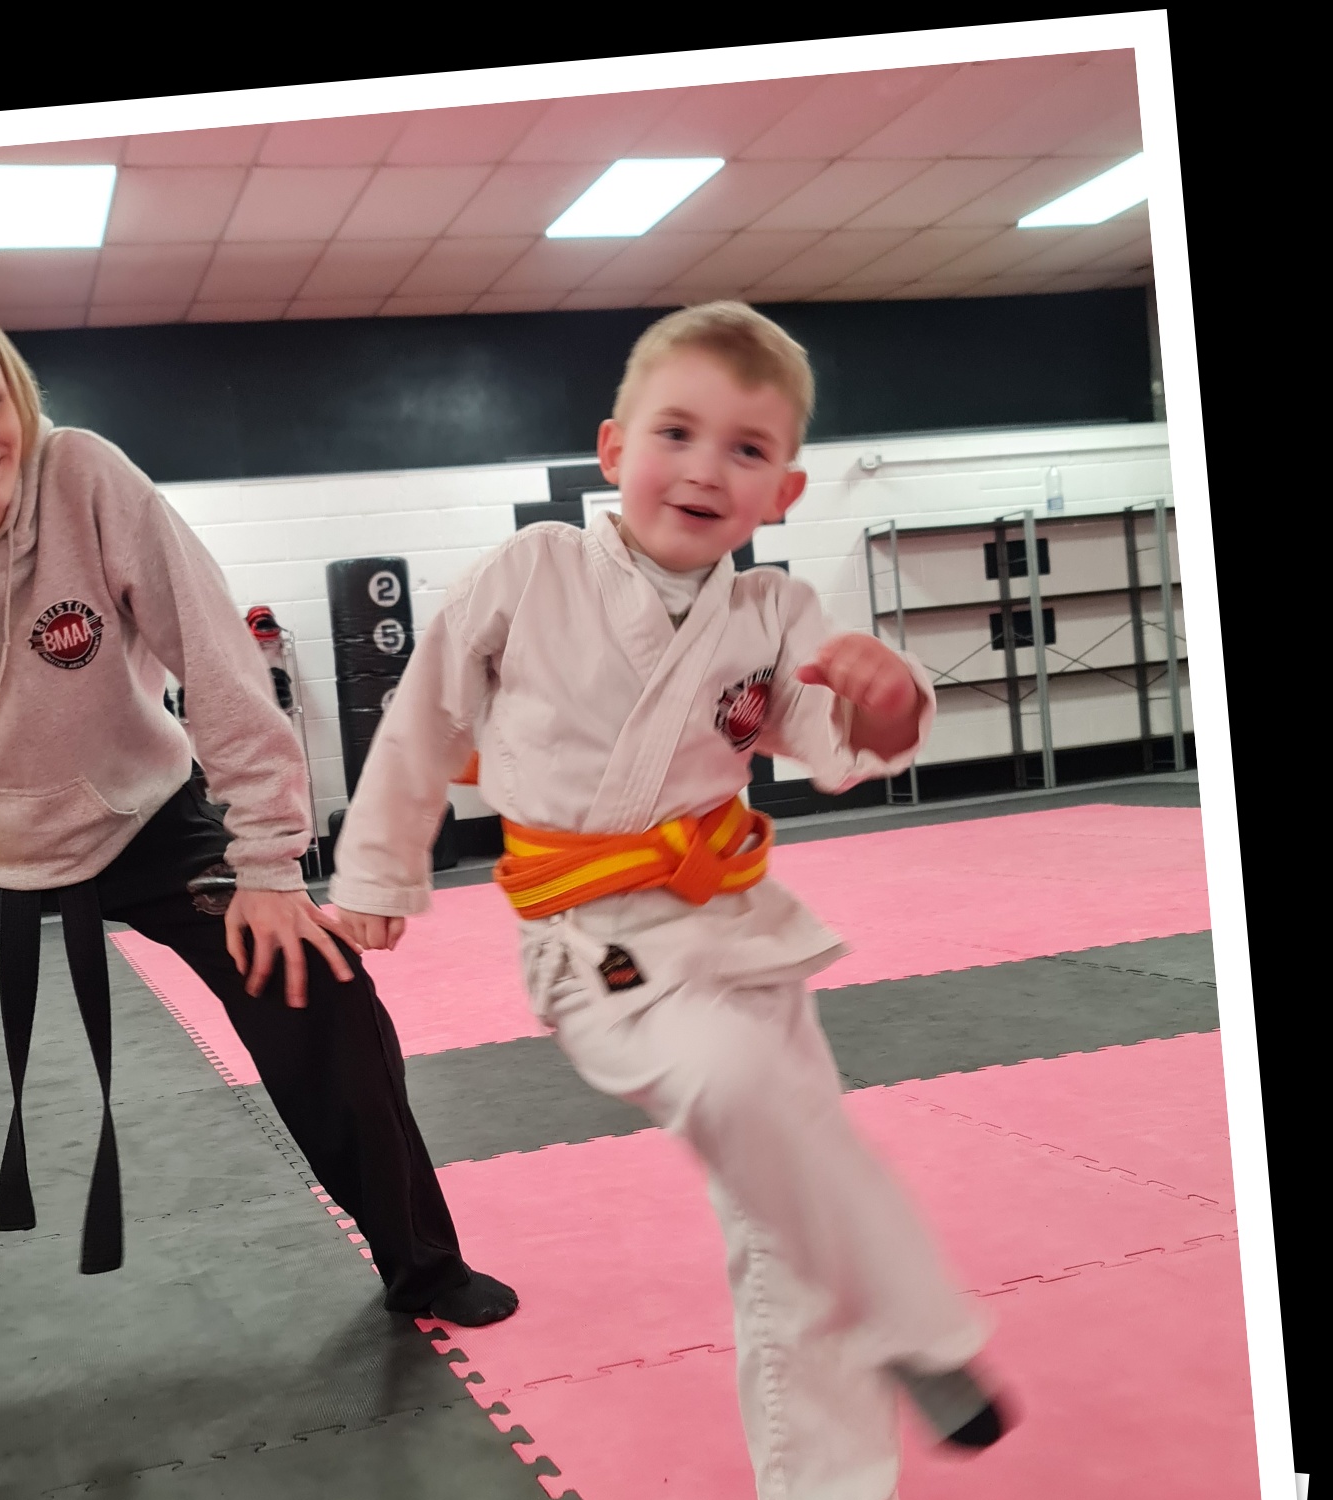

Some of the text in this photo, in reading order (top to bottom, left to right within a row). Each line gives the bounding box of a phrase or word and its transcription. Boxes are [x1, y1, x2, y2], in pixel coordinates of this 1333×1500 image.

[376, 577, 395, 601] 2
[34, 601, 89, 632] BRISTOL
[42, 618, 94, 652] BMAA
[381, 625, 400, 649] 5
